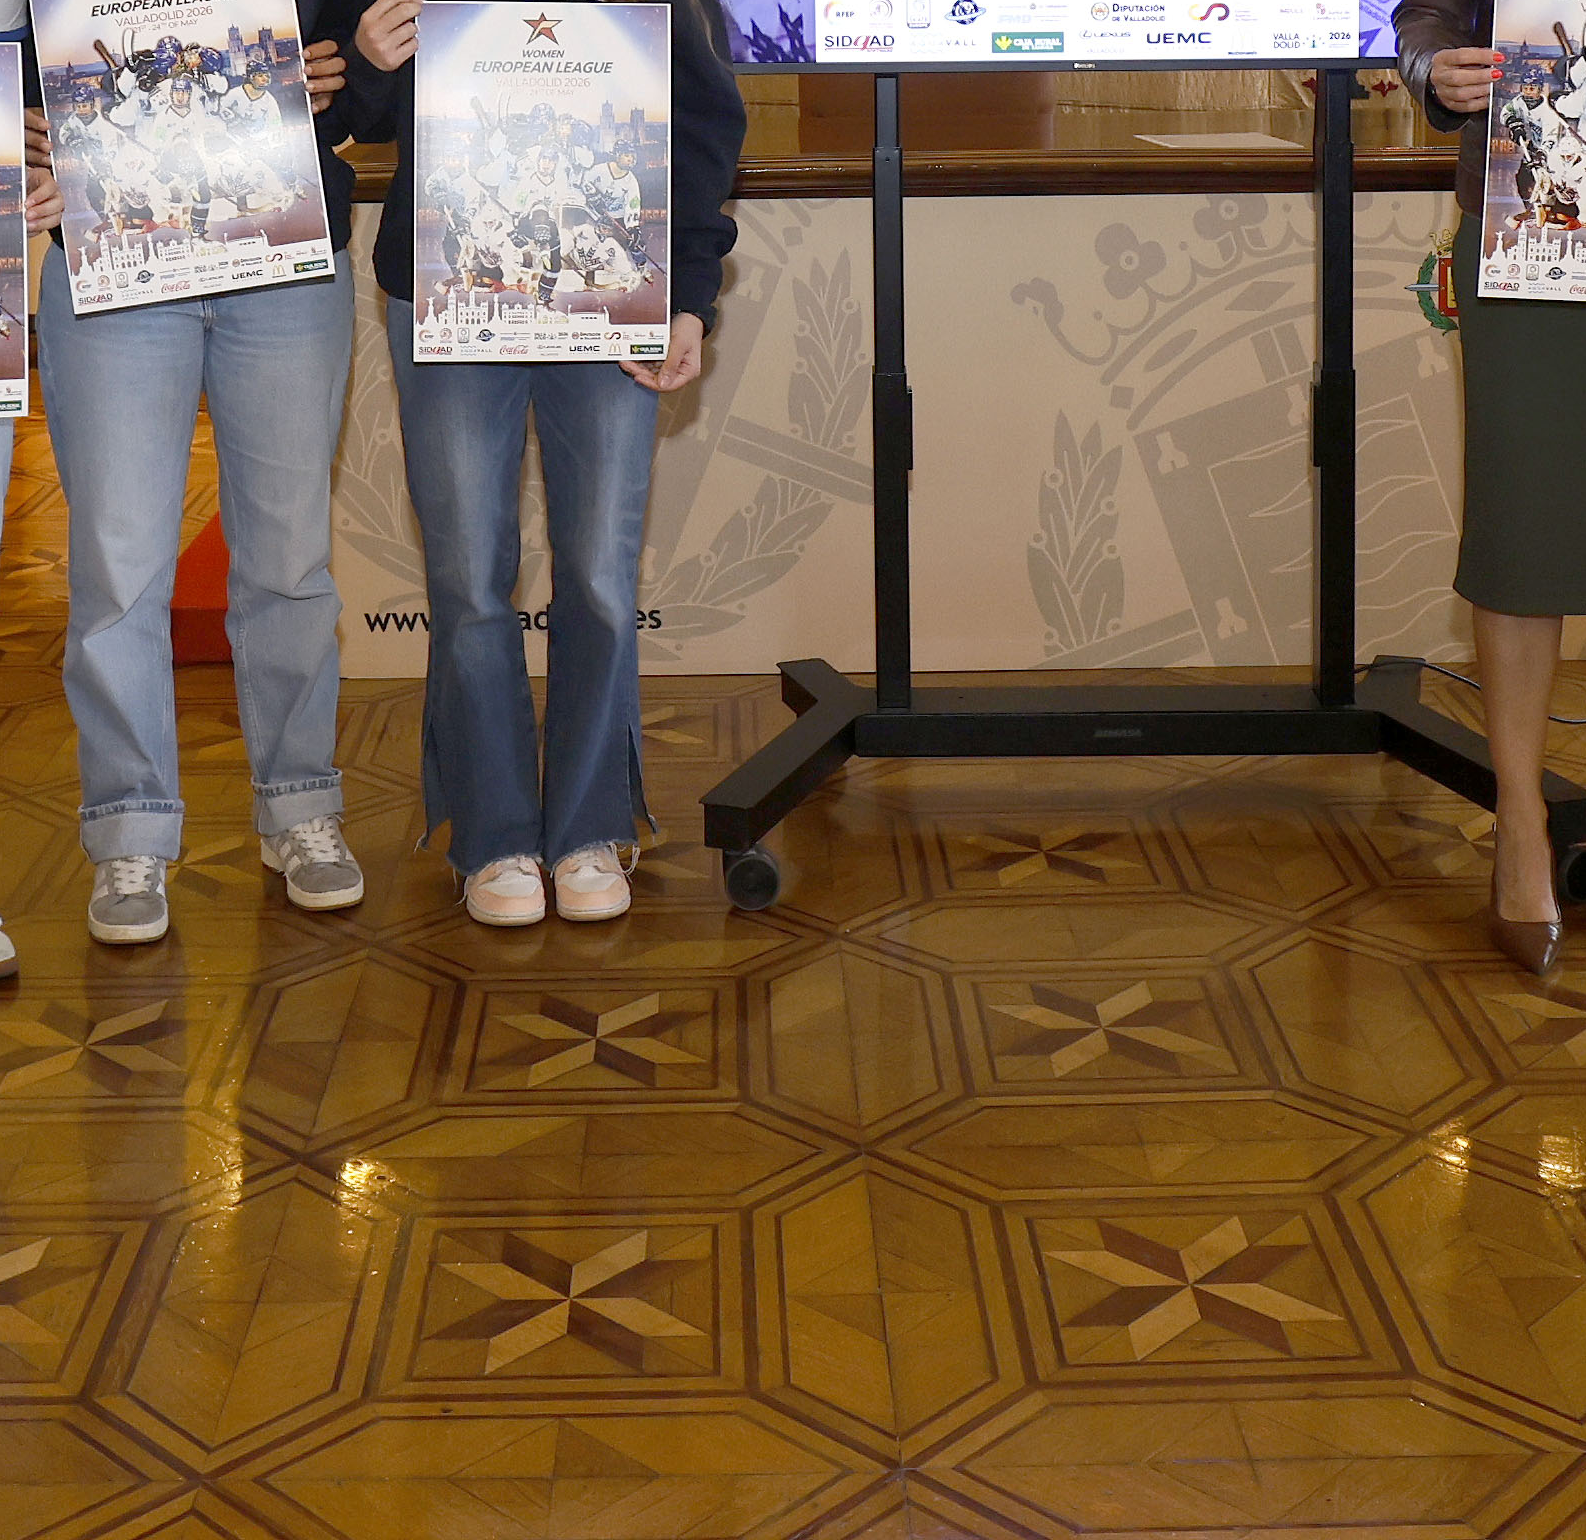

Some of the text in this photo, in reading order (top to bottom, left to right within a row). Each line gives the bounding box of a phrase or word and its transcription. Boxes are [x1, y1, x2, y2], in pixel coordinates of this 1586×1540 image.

[115, 6, 213, 27] VALLADOLID 2026
[1146, 32, 1212, 44] UEMC
[1273, 31, 1351, 41] VALLA 2026
[522, 49, 565, 58] WOMEN
[473, 61, 613, 73] EUROPEAN LEAGUE
[564, 77, 591, 87] 2026
[231, 269, 264, 280] UEMC
